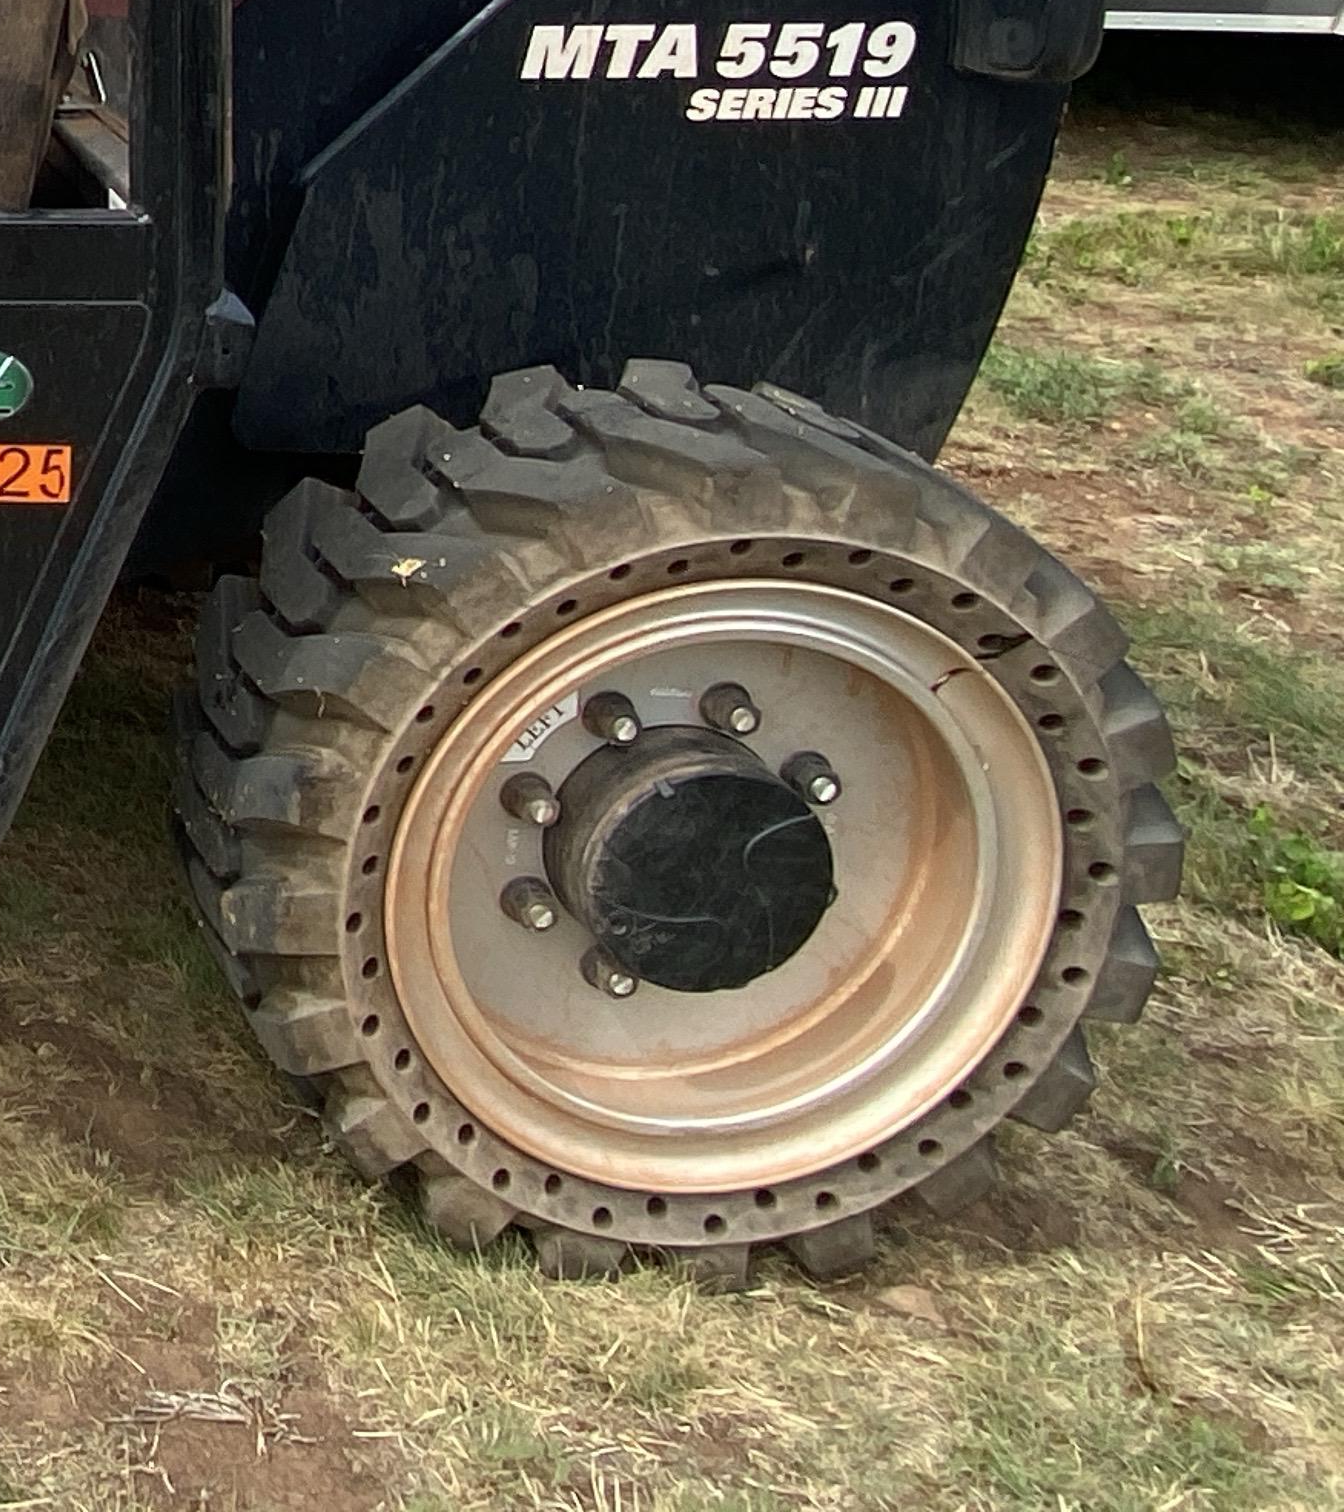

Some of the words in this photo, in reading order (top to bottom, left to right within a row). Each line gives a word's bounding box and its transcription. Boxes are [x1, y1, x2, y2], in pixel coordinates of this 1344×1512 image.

[519, 23, 699, 80] MTA
[715, 21, 916, 79] 5519
[686, 87, 848, 122] SERIES
[852, 86, 909, 119] III
